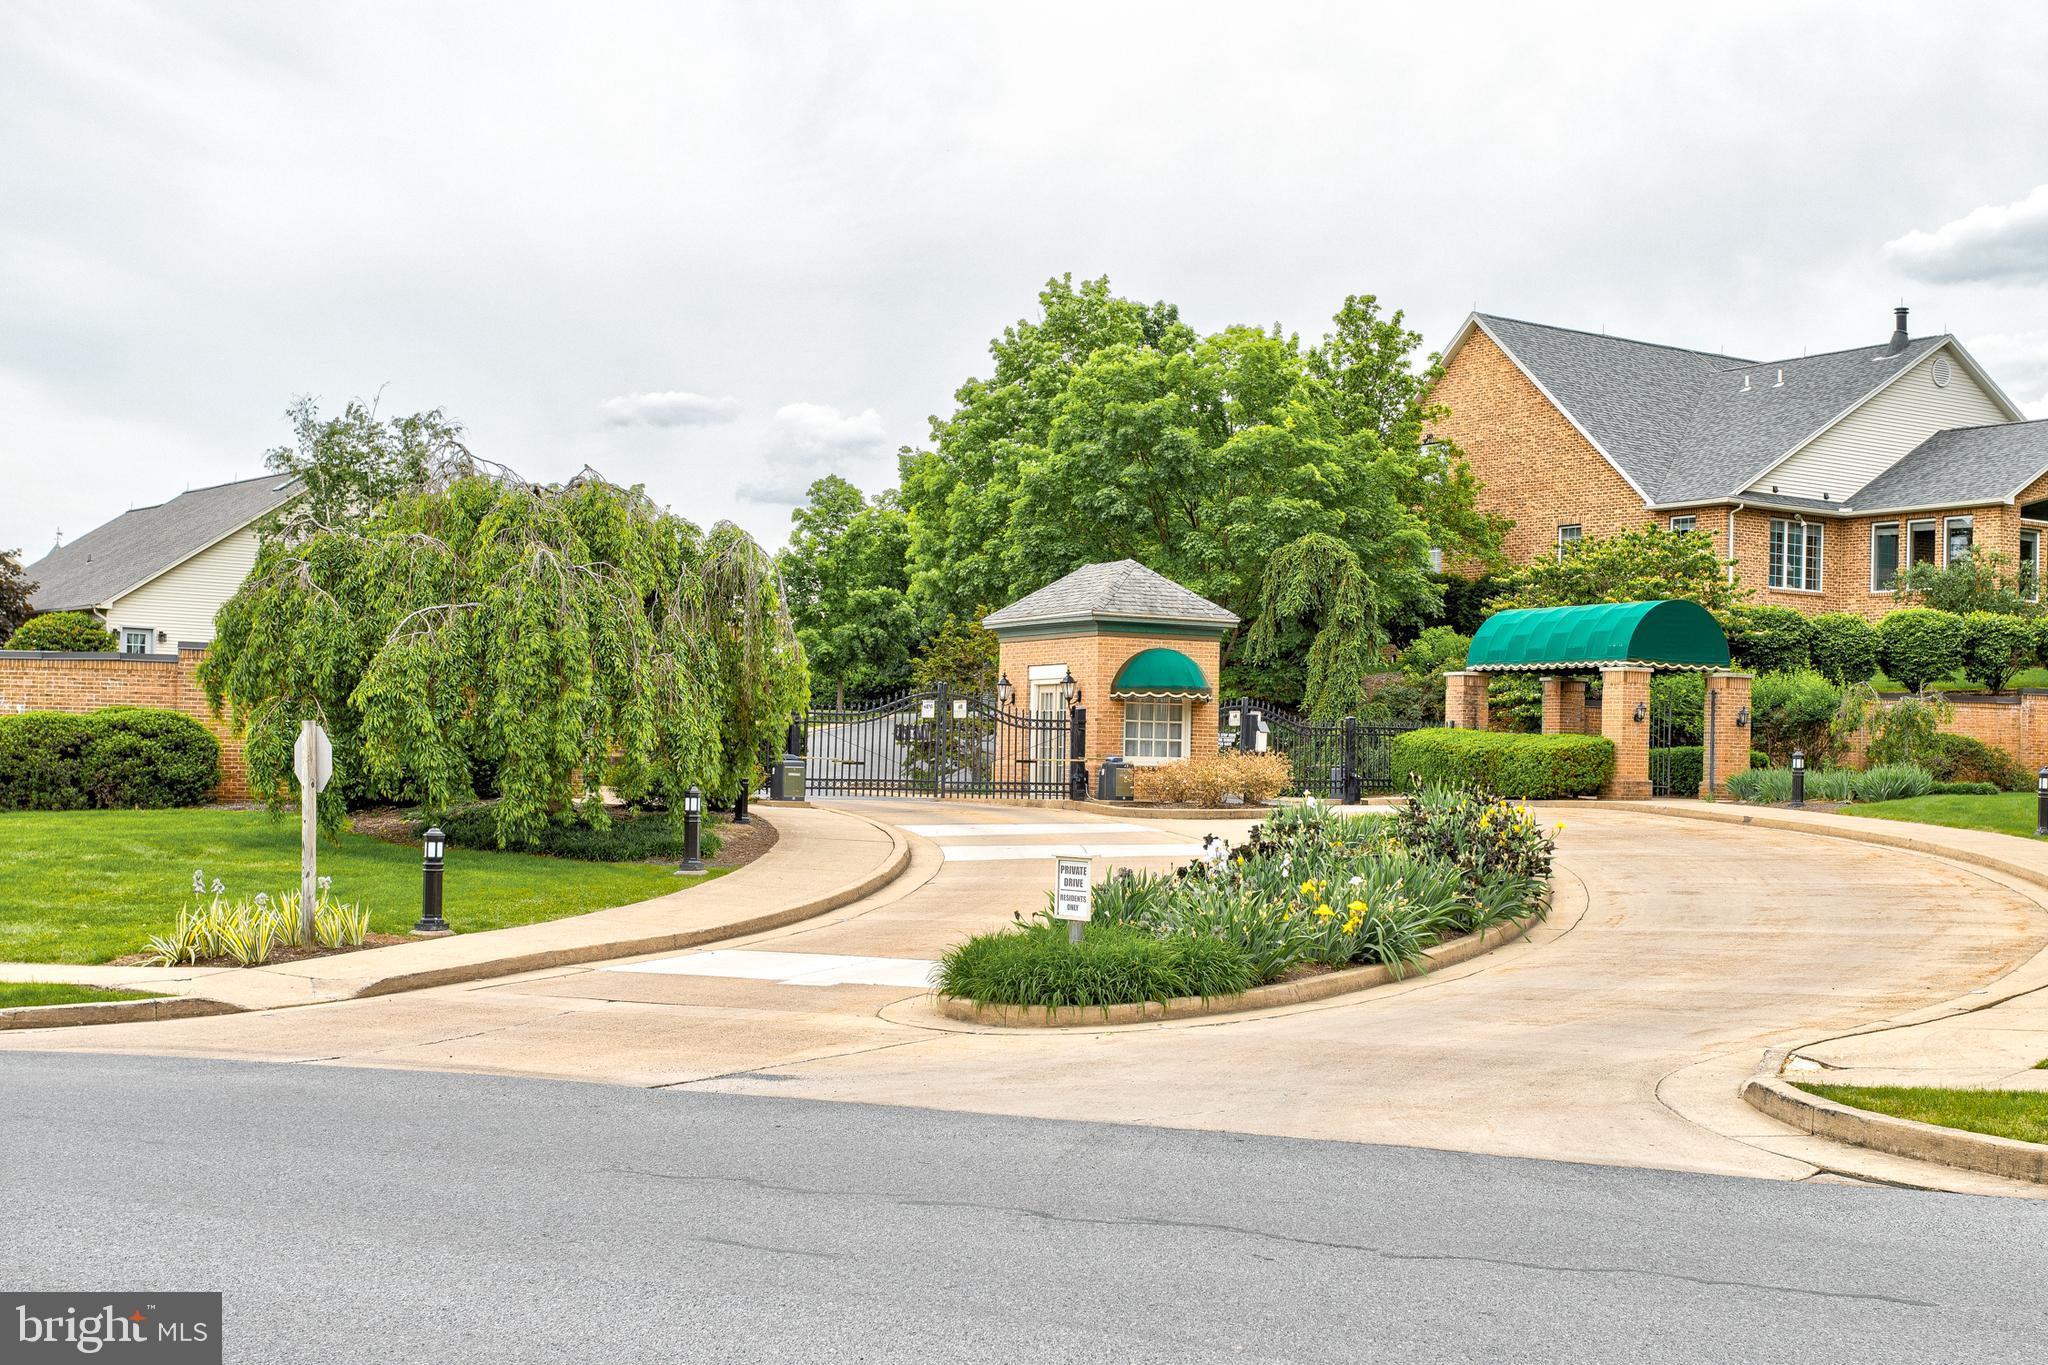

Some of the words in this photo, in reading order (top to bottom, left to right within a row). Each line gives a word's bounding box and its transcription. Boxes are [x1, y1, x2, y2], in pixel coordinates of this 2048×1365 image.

[1060, 865, 1087, 876] PRIVATE
[1064, 878, 1084, 888] DRIVE
[1060, 894, 1087, 903] RESIDENTS
